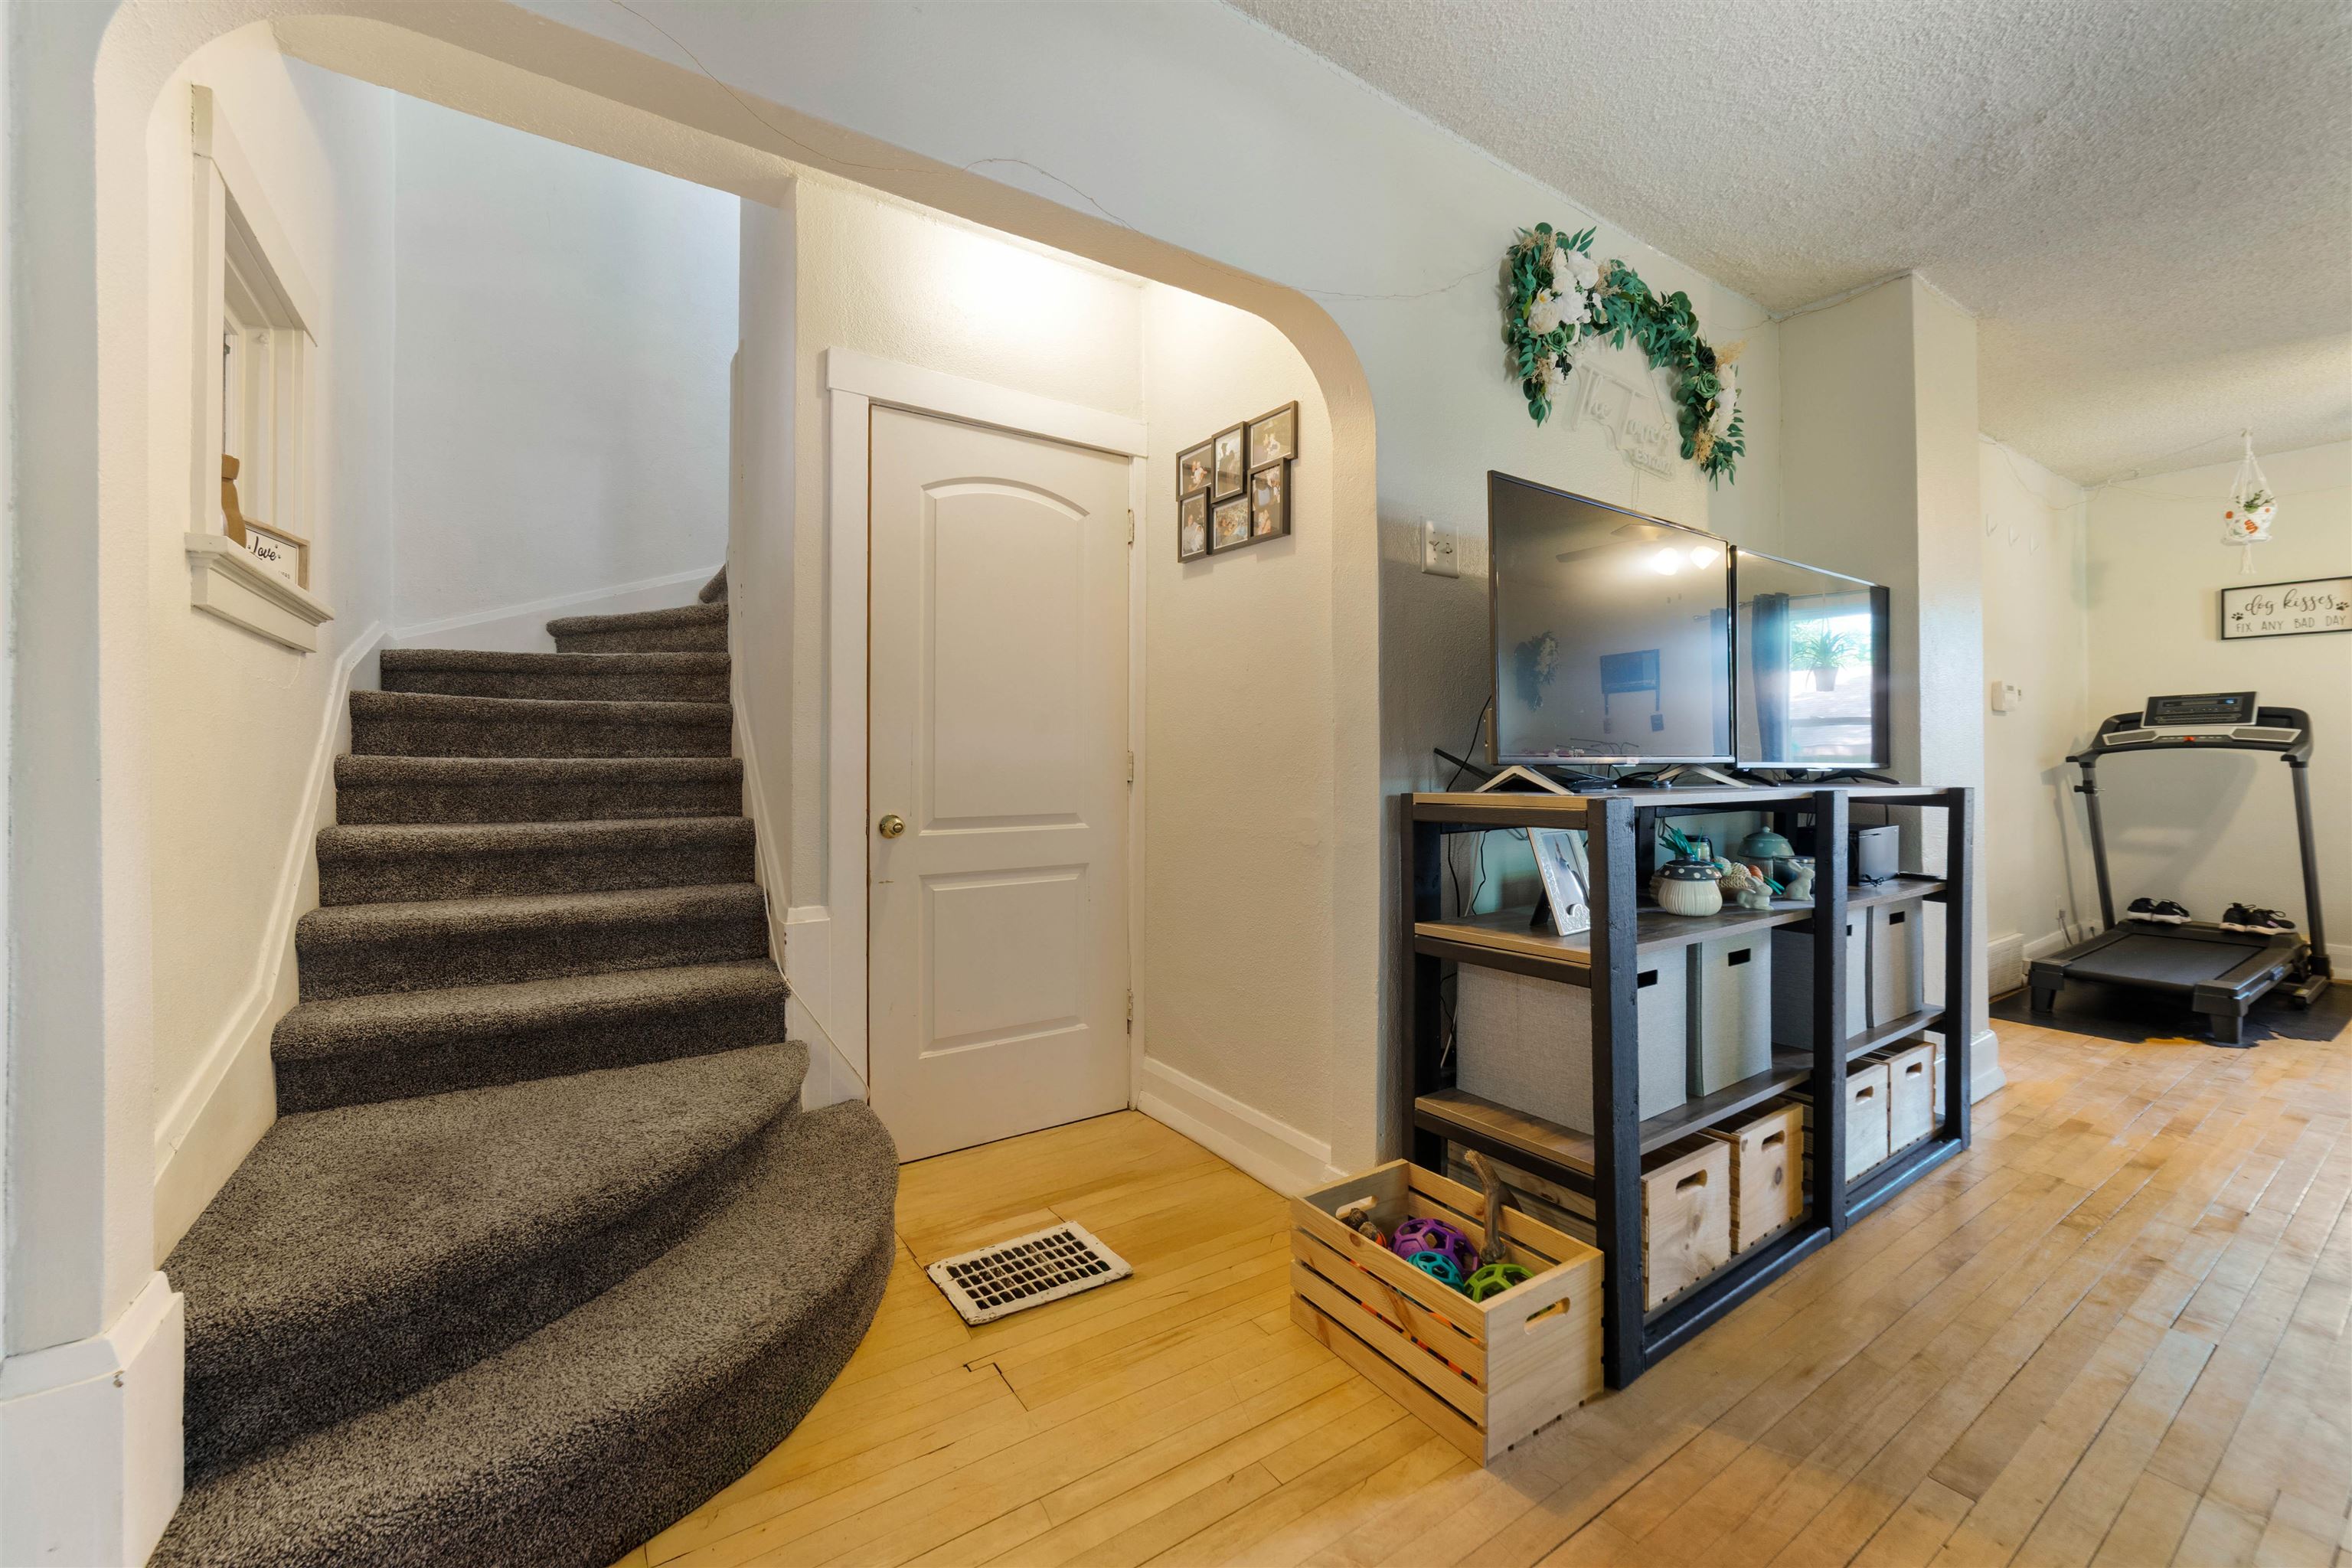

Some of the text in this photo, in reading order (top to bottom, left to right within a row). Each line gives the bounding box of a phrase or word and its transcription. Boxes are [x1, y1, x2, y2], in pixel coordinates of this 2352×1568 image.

[2245, 589, 2336, 616] dog kisses
[2236, 616, 2347, 633] FIX ANY BAD DAY
